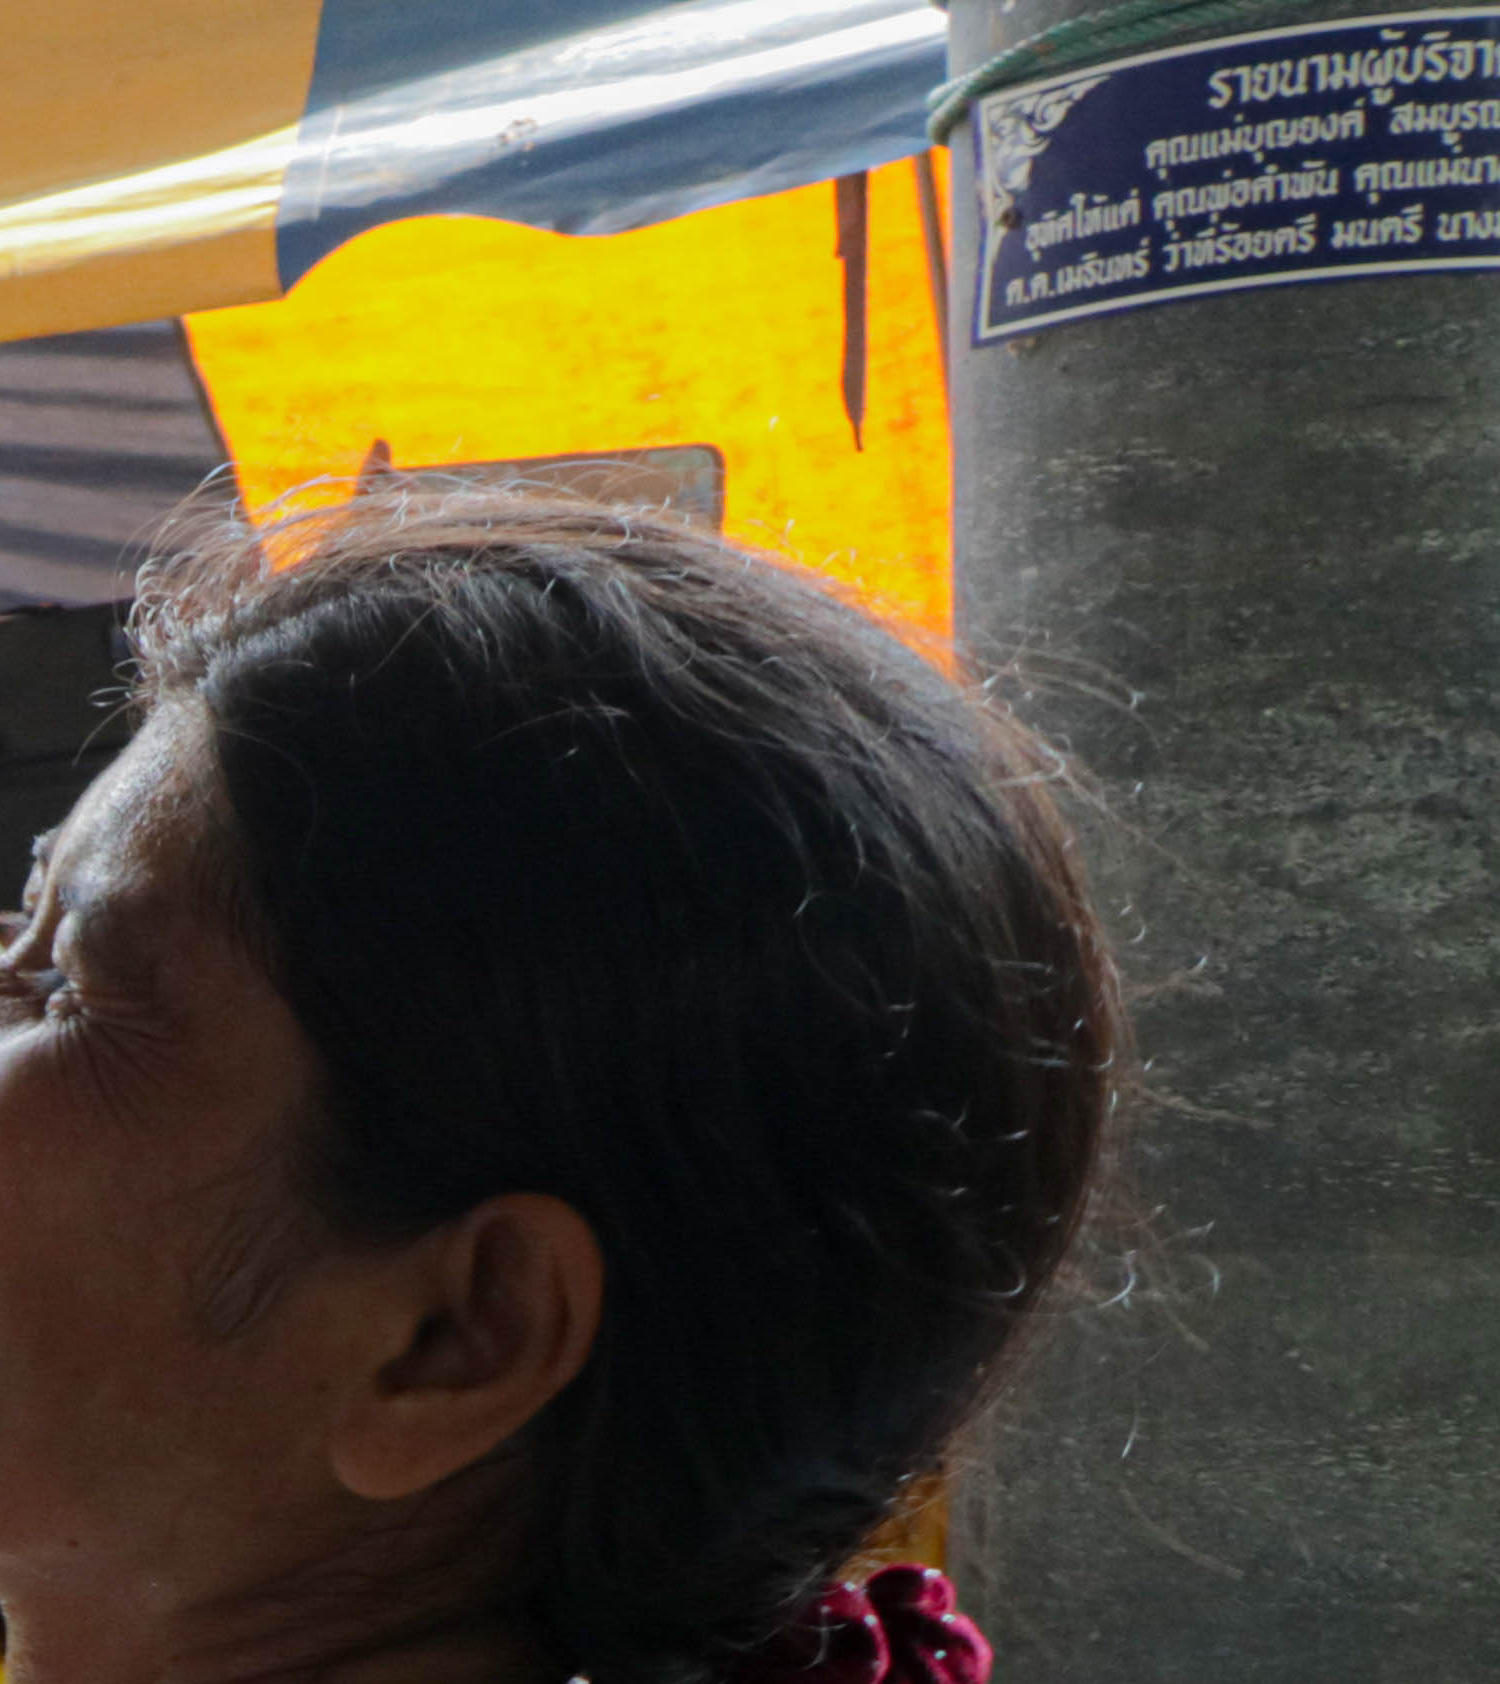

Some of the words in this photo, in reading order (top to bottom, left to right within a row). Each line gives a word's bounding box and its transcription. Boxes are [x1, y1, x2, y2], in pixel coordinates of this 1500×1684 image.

[1207, 28, 1500, 109] รายนามผู้บริจา
